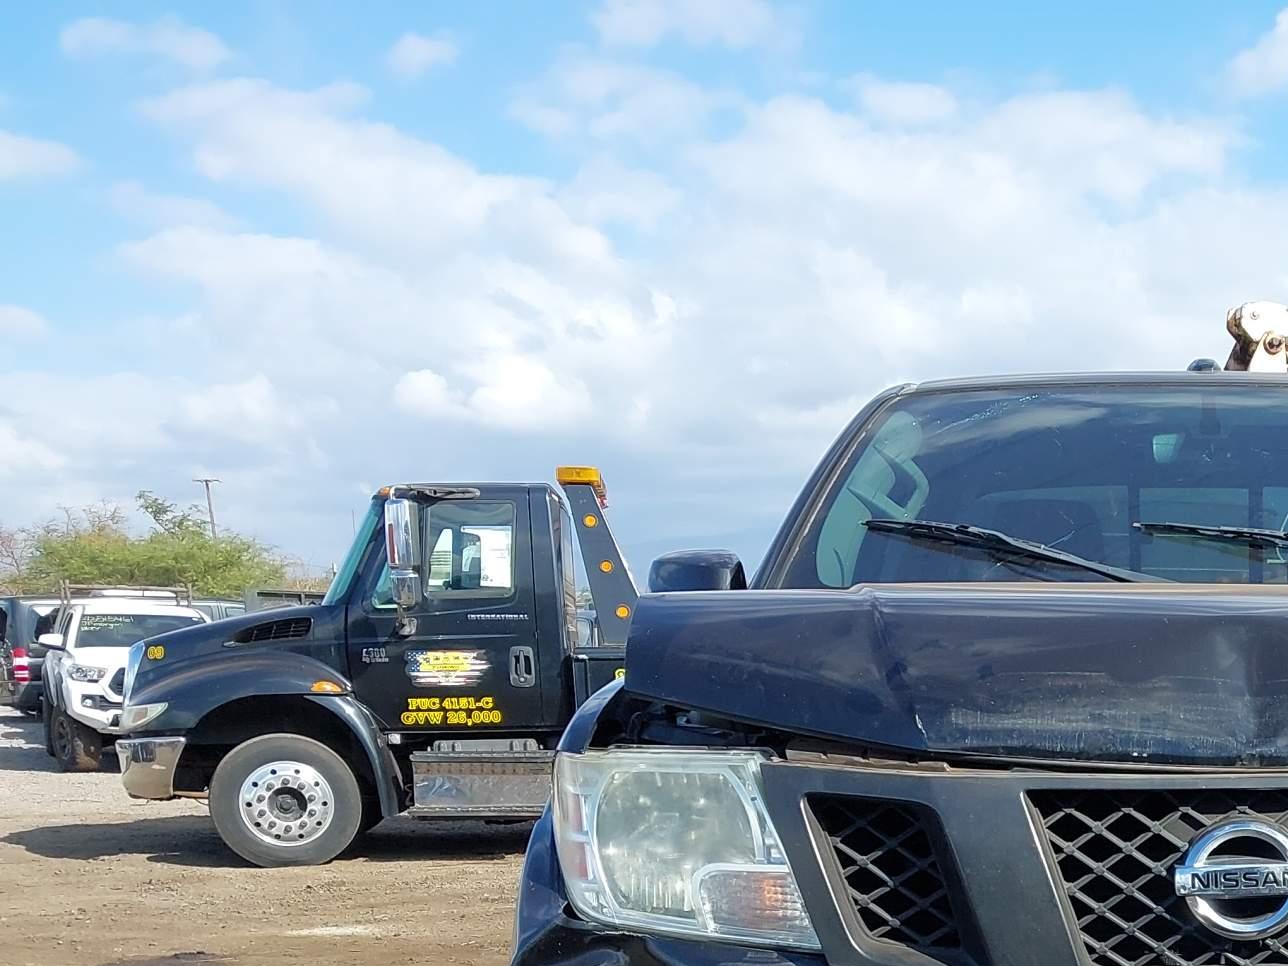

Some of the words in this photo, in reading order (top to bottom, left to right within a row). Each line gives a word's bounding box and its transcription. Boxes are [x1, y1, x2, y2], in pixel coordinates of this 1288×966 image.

[407, 698, 440, 710] PUC
[442, 697, 493, 710] 4151-C
[400, 711, 444, 725] GVW
[446, 711, 502, 726] 26,000
